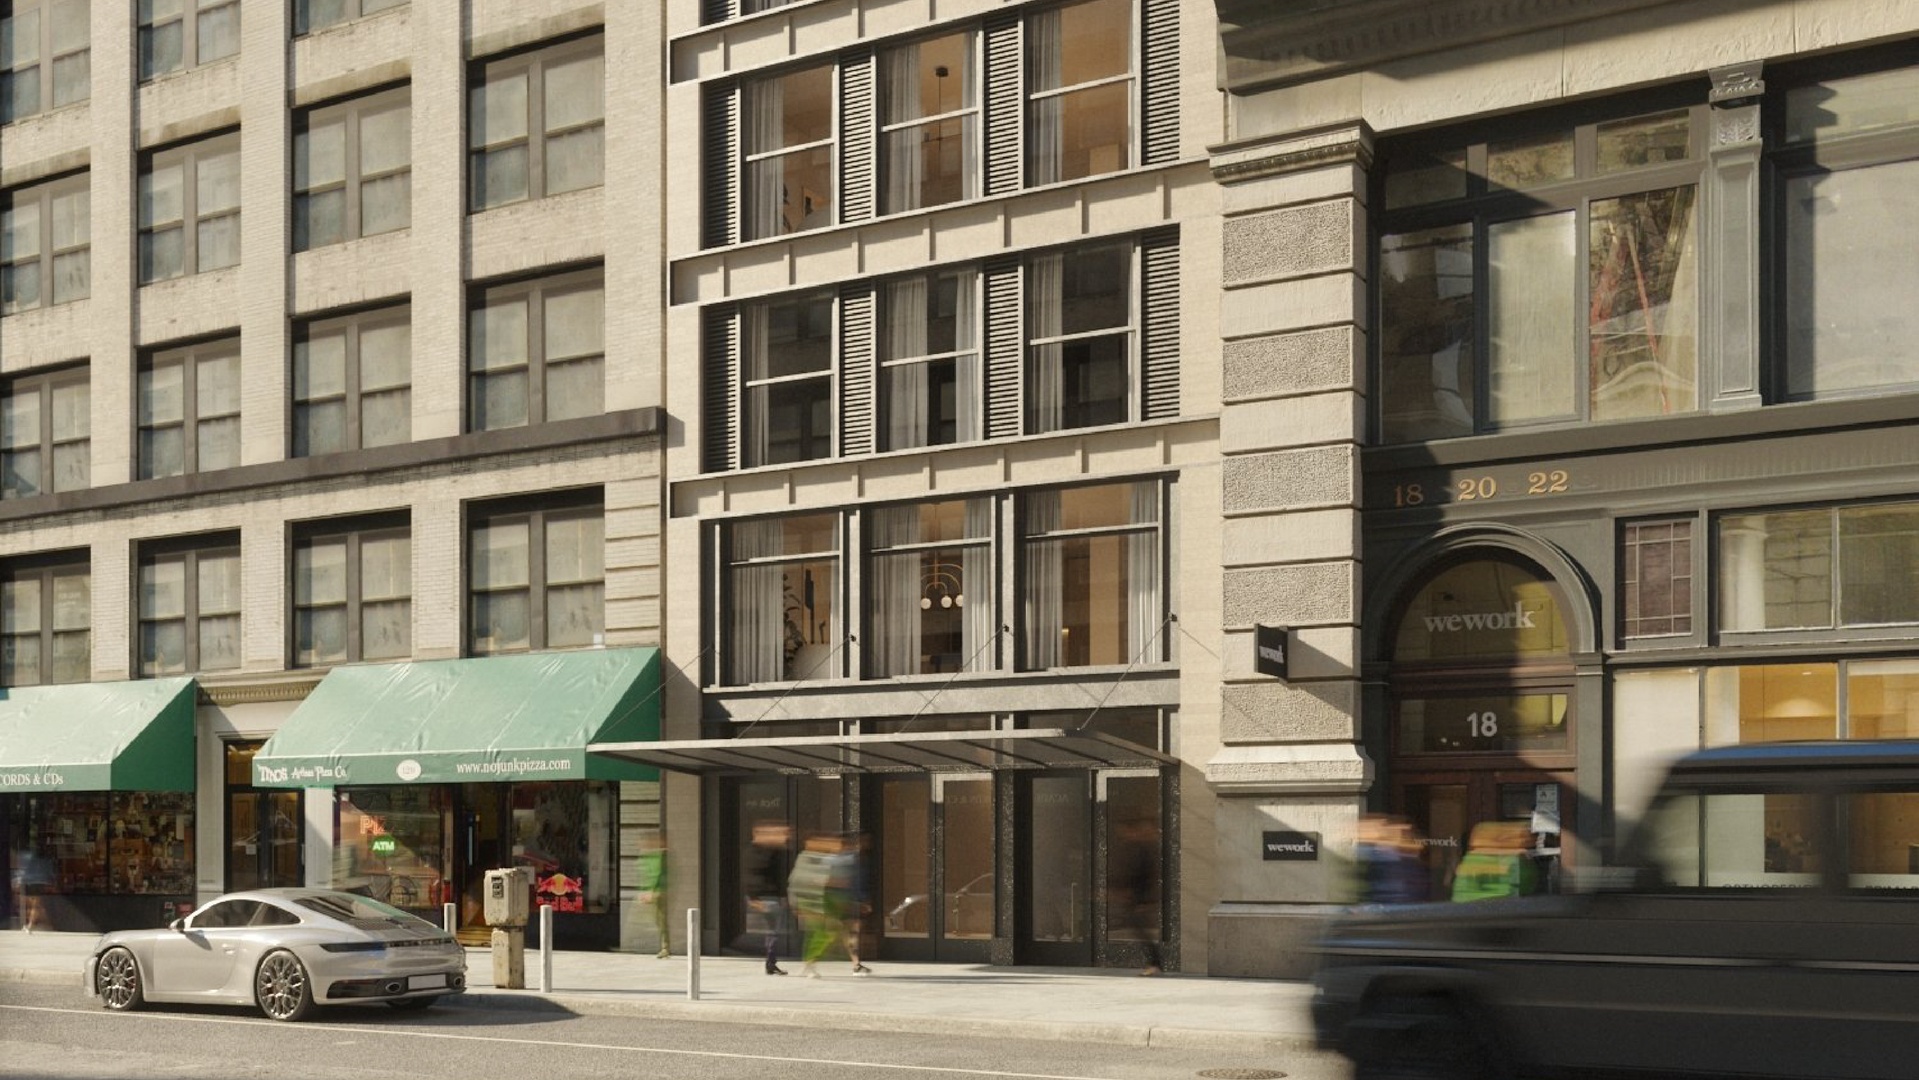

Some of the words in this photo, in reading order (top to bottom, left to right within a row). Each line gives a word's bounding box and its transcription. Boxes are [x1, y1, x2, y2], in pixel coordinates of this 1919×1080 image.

[1394, 484, 1423, 507] 18
[1457, 476, 1497, 500] 20
[1528, 470, 1568, 494] 22
[1424, 601, 1536, 632] wework
[1467, 712, 1498, 738] 18
[456, 757, 571, 775] www.nojunkpizza.com
[33, 773, 41, 785] &
[43, 773, 64, 785] CDs
[372, 841, 395, 851] ATM
[1267, 839, 1315, 853] wework
